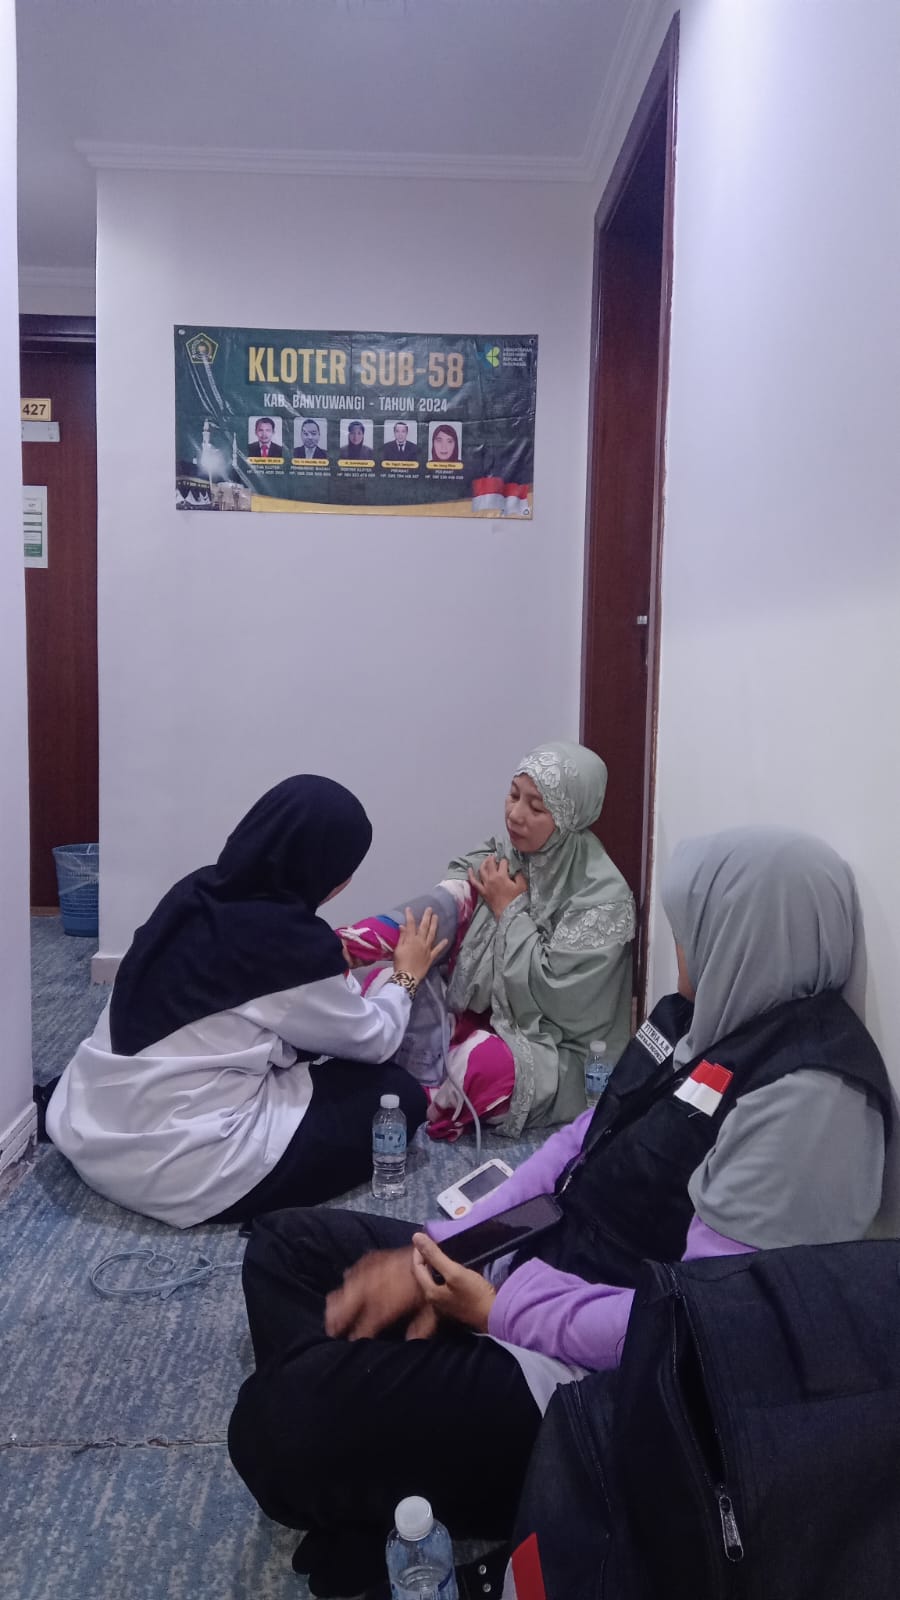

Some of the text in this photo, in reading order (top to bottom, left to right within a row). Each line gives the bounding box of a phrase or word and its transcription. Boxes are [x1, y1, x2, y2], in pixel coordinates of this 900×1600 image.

[248, 346, 464, 388] KLOTER SUB-58
[22, 403, 47, 416] 427
[292, 394, 365, 411] BANYUWANGI
[379, 397, 415, 412] TAHUN
[418, 398, 448, 413] 2024
